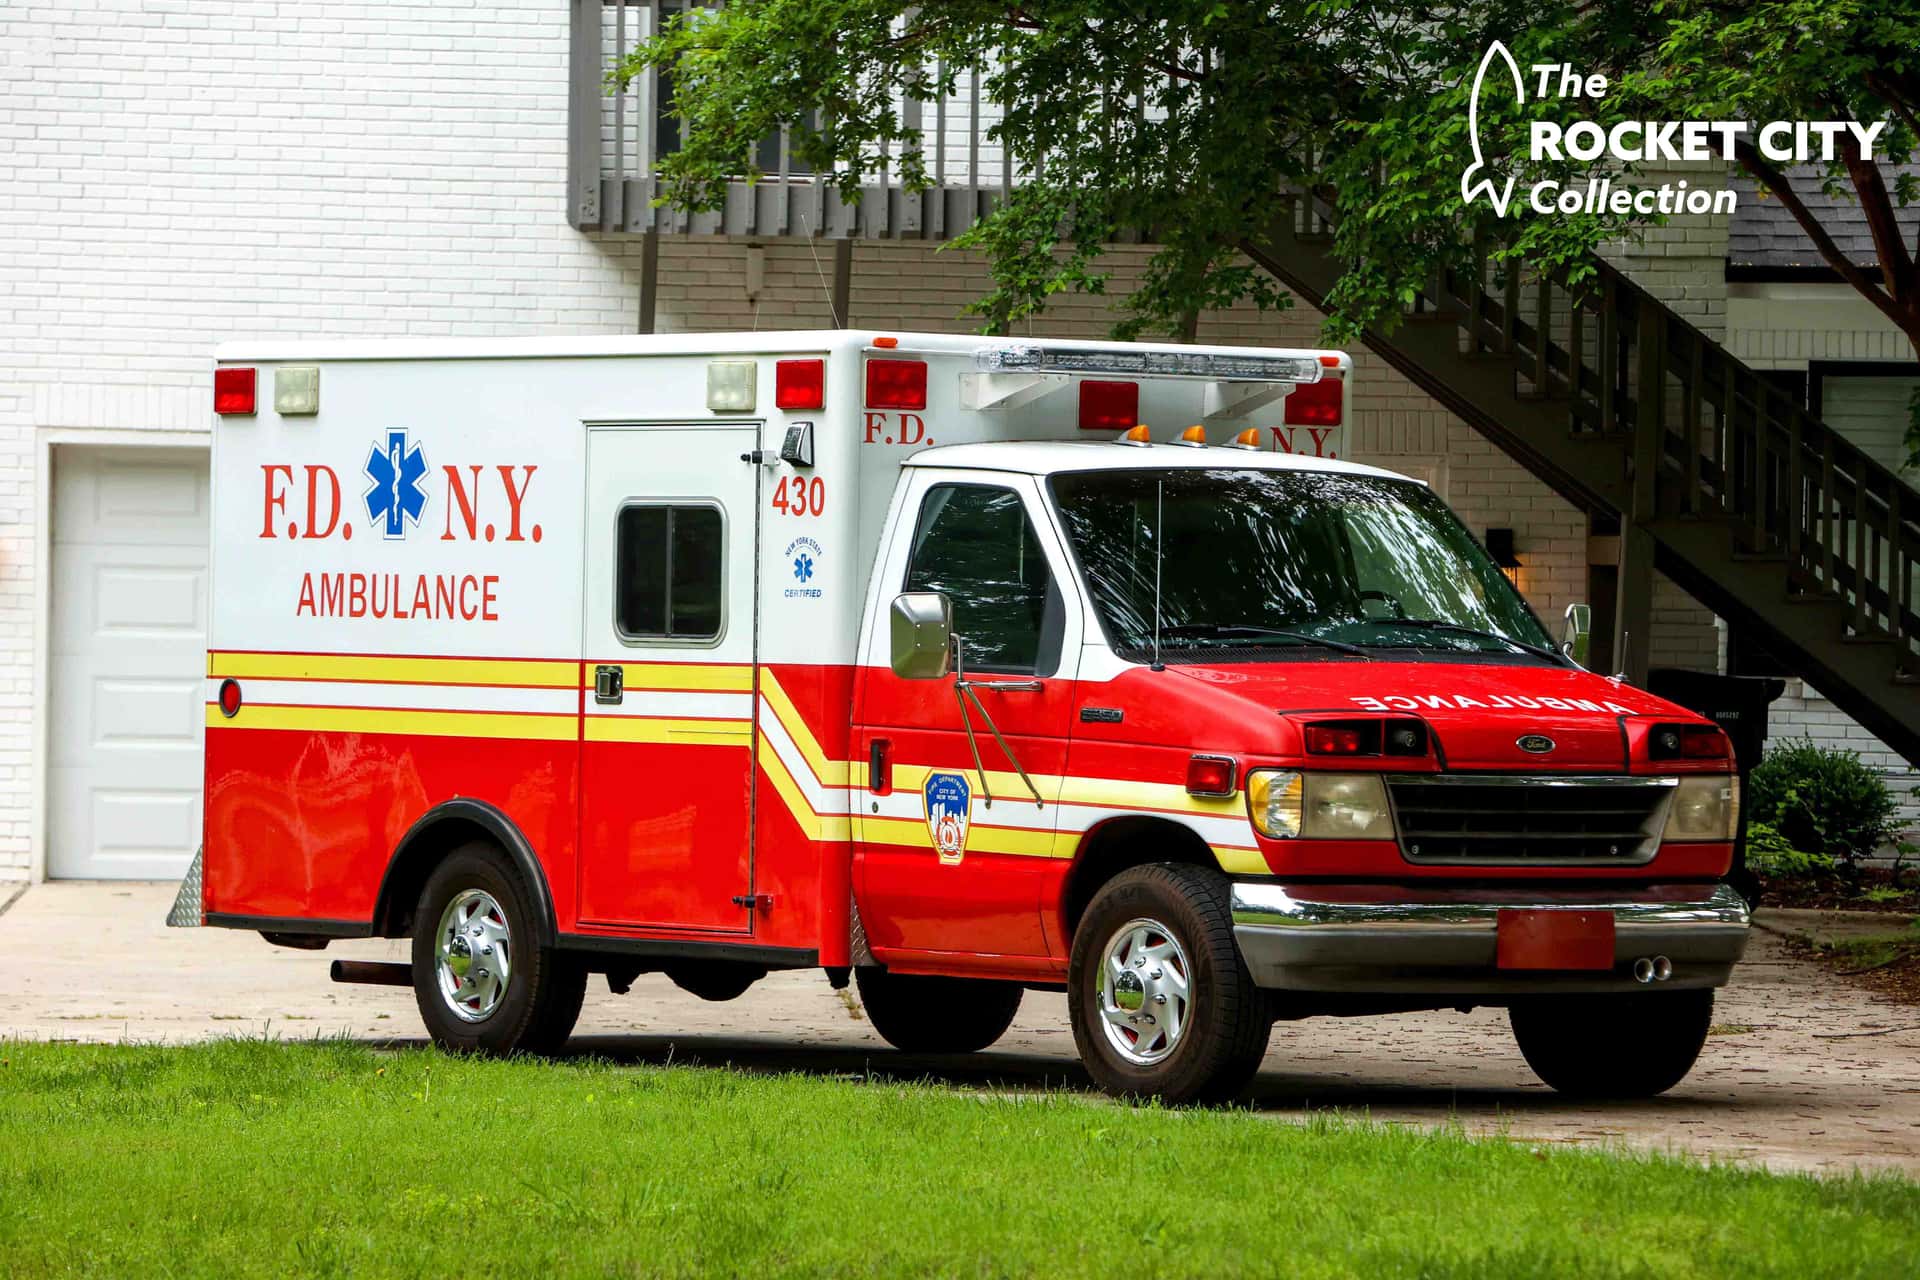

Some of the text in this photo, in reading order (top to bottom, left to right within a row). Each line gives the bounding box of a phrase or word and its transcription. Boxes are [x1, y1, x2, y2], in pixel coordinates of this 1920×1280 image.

[863, 411, 934, 446] F.D.
[1269, 426, 1337, 459] N.Y.
[259, 464, 543, 543] F.D. N.Y.
[772, 475, 825, 517] 430
[785, 536, 822, 557] NEW YORK STATE
[296, 572, 499, 622] AMBULANCE
[784, 588, 822, 598] CERTIFIED
